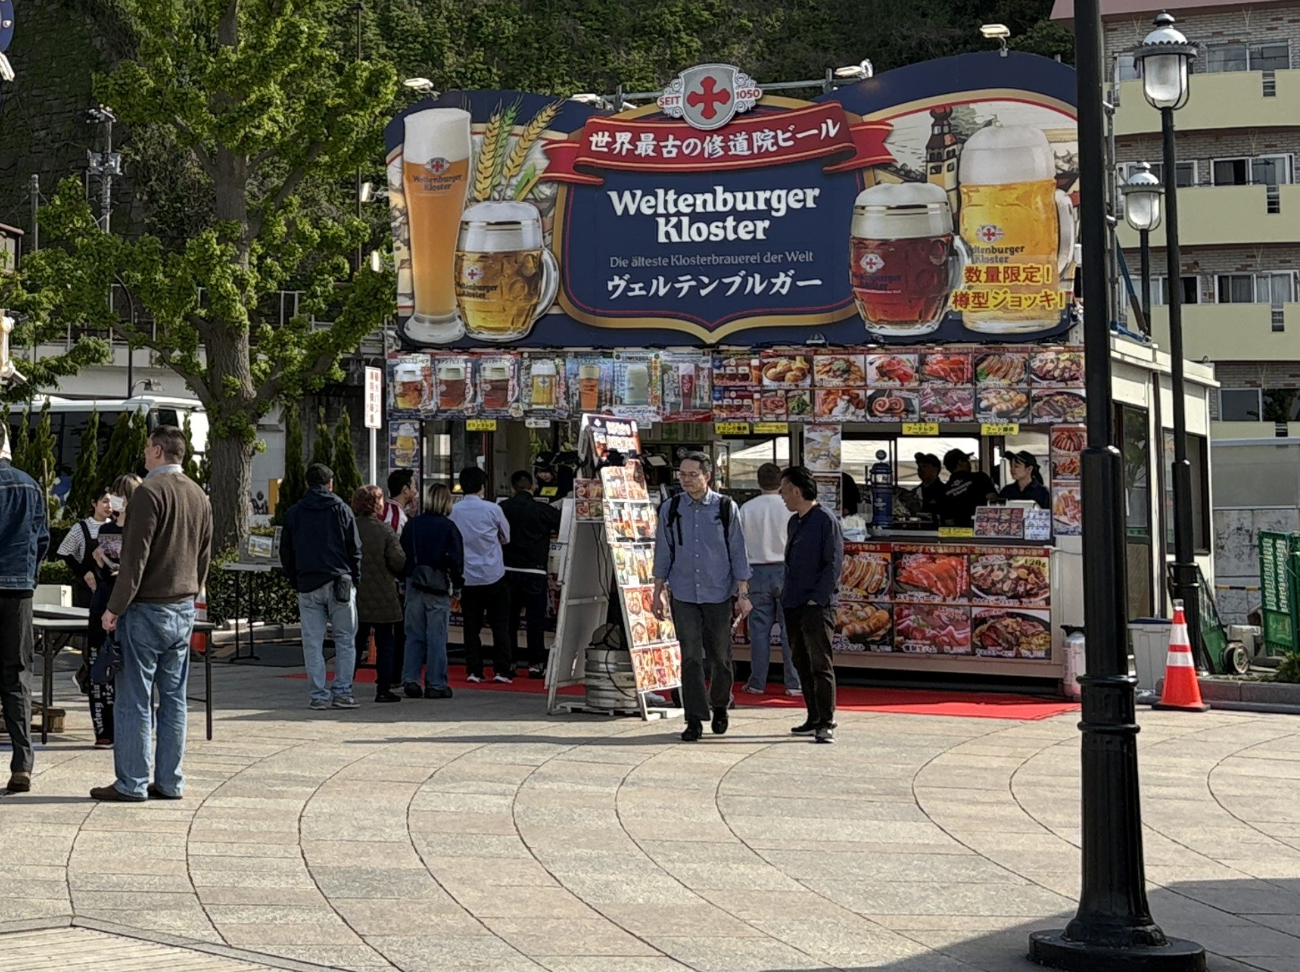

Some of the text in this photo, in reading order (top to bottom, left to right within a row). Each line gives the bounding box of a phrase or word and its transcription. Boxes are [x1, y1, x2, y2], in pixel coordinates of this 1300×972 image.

[658, 90, 760, 106] SEIT 1050
[589, 118, 841, 159] 世界最古の修道院ビール
[607, 186, 820, 217] Weltenburger
[655, 215, 770, 243] Kloster
[610, 250, 814, 267] Die älteste Klosterbrauerei der Welt
[607, 269, 823, 300] ヴェルテンブルガー
